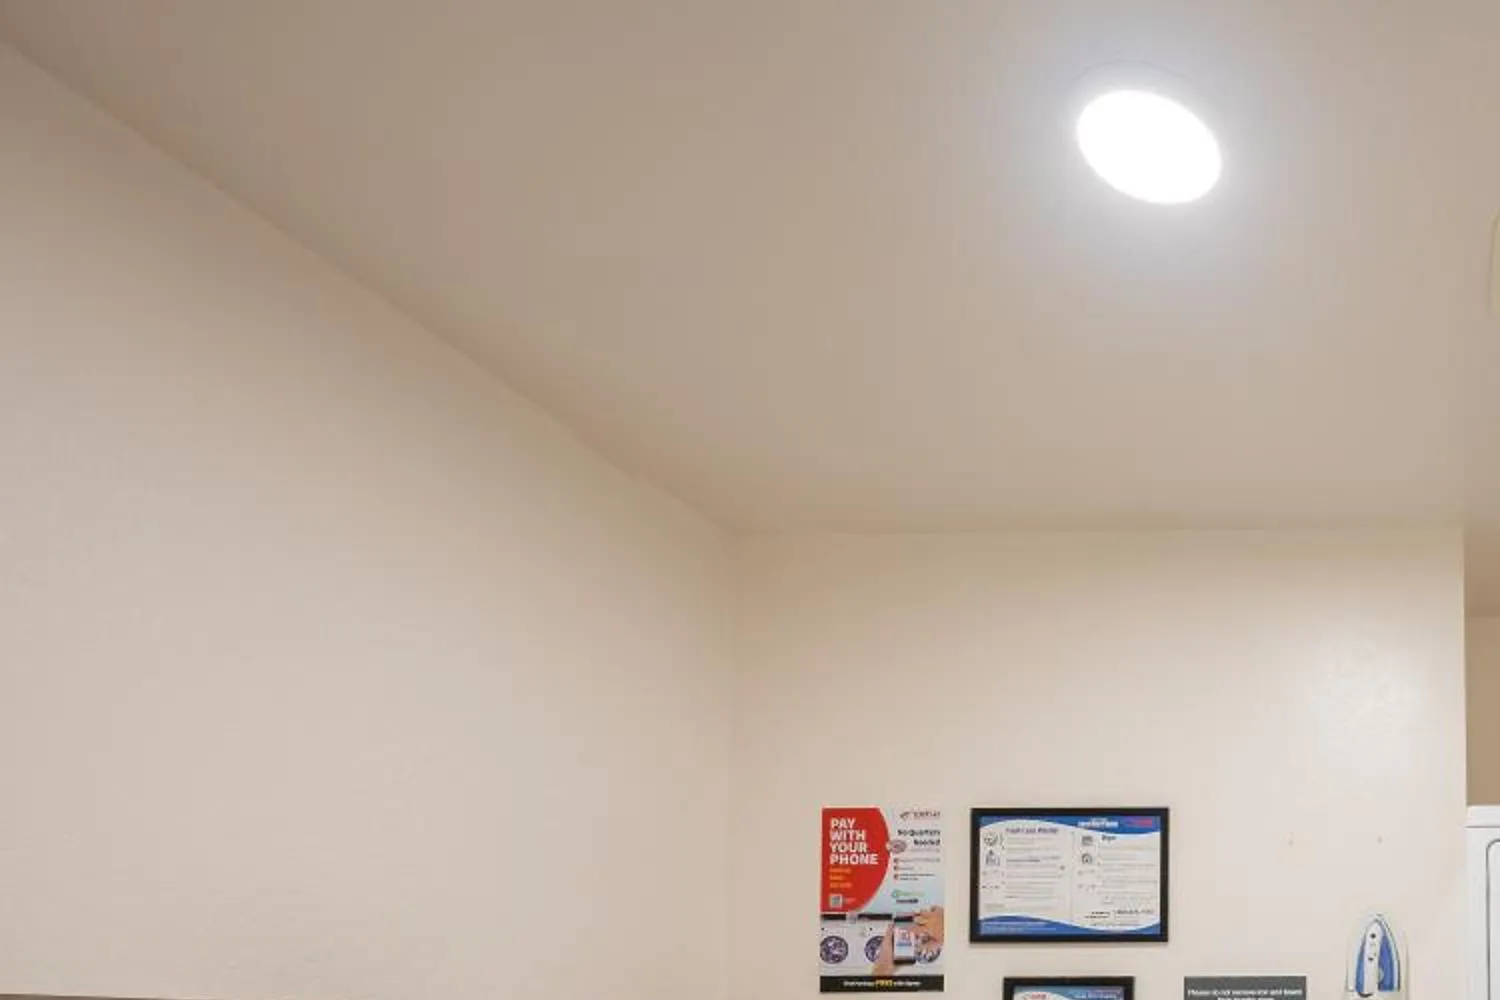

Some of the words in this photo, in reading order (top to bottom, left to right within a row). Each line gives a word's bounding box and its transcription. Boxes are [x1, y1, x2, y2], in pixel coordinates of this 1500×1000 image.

[831, 818, 856, 829] PAY
[830, 830, 866, 841] WITH
[829, 842, 868, 853] YOUR
[830, 854, 879, 865] PHONE
